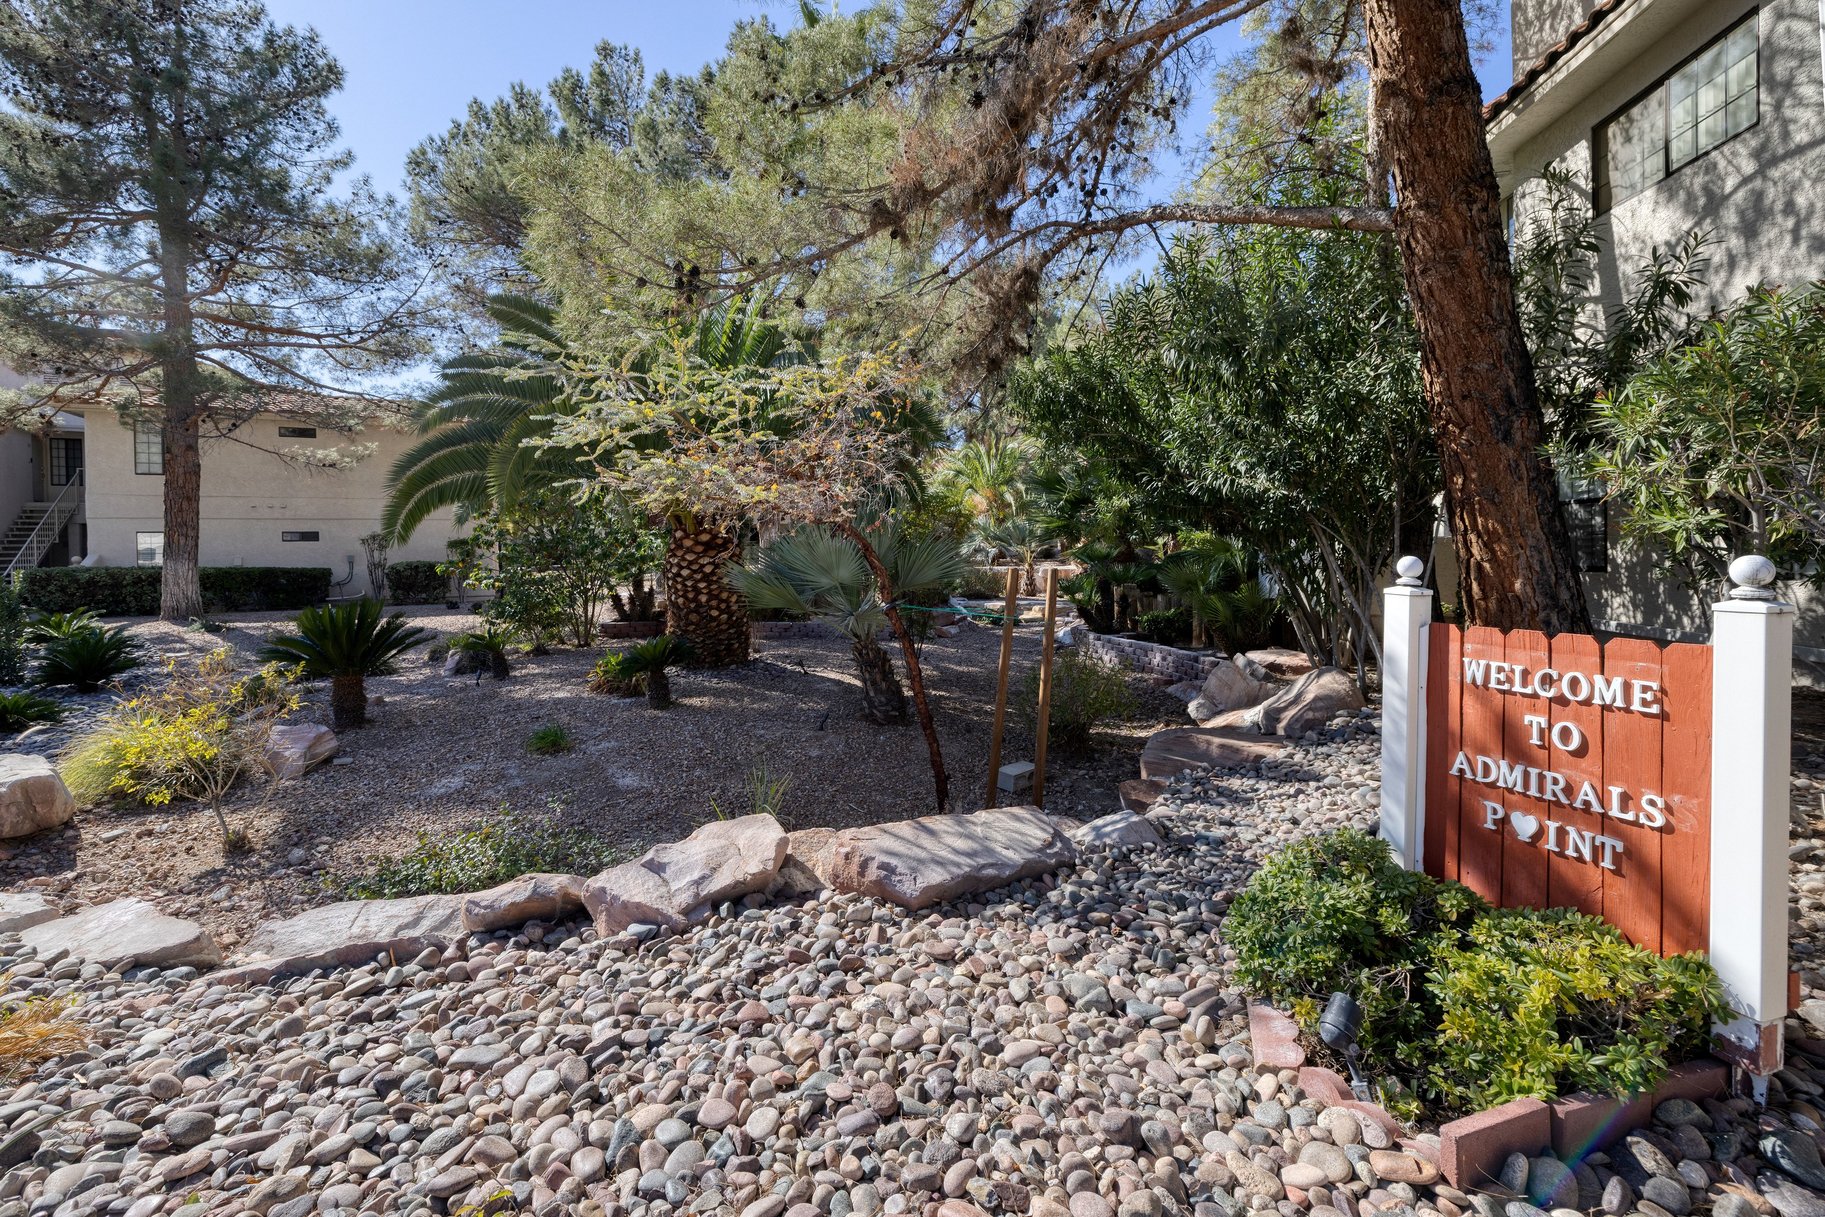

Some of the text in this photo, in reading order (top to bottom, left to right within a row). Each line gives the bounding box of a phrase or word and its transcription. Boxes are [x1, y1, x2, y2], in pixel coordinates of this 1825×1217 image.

[1463, 658, 1660, 714] WELCOME
[1524, 715, 1582, 751] TO
[1449, 751, 1667, 828] ADMIRALS
